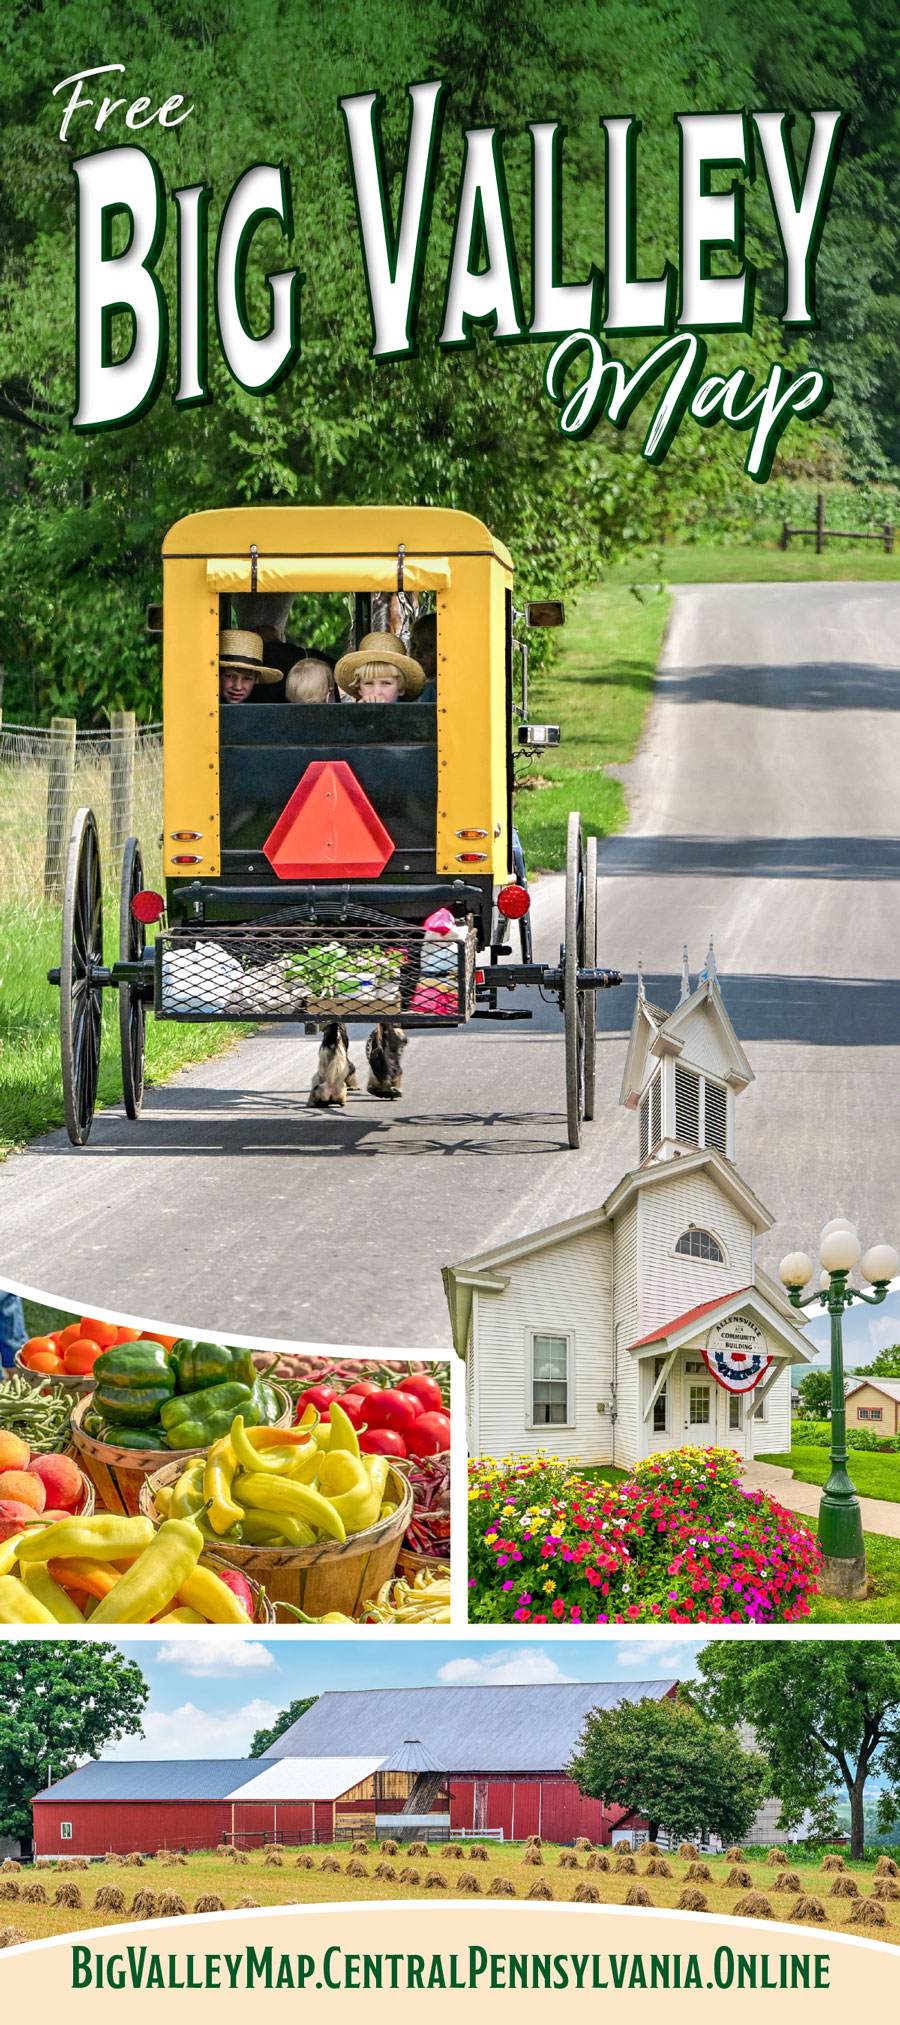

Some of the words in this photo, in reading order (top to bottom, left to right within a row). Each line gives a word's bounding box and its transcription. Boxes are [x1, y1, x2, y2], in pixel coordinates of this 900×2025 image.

[716, 1316, 761, 1337] ALLENSVILLE
[721, 1333, 756, 1341] COMMUNITY
[725, 1342, 752, 1350] BUILDING
